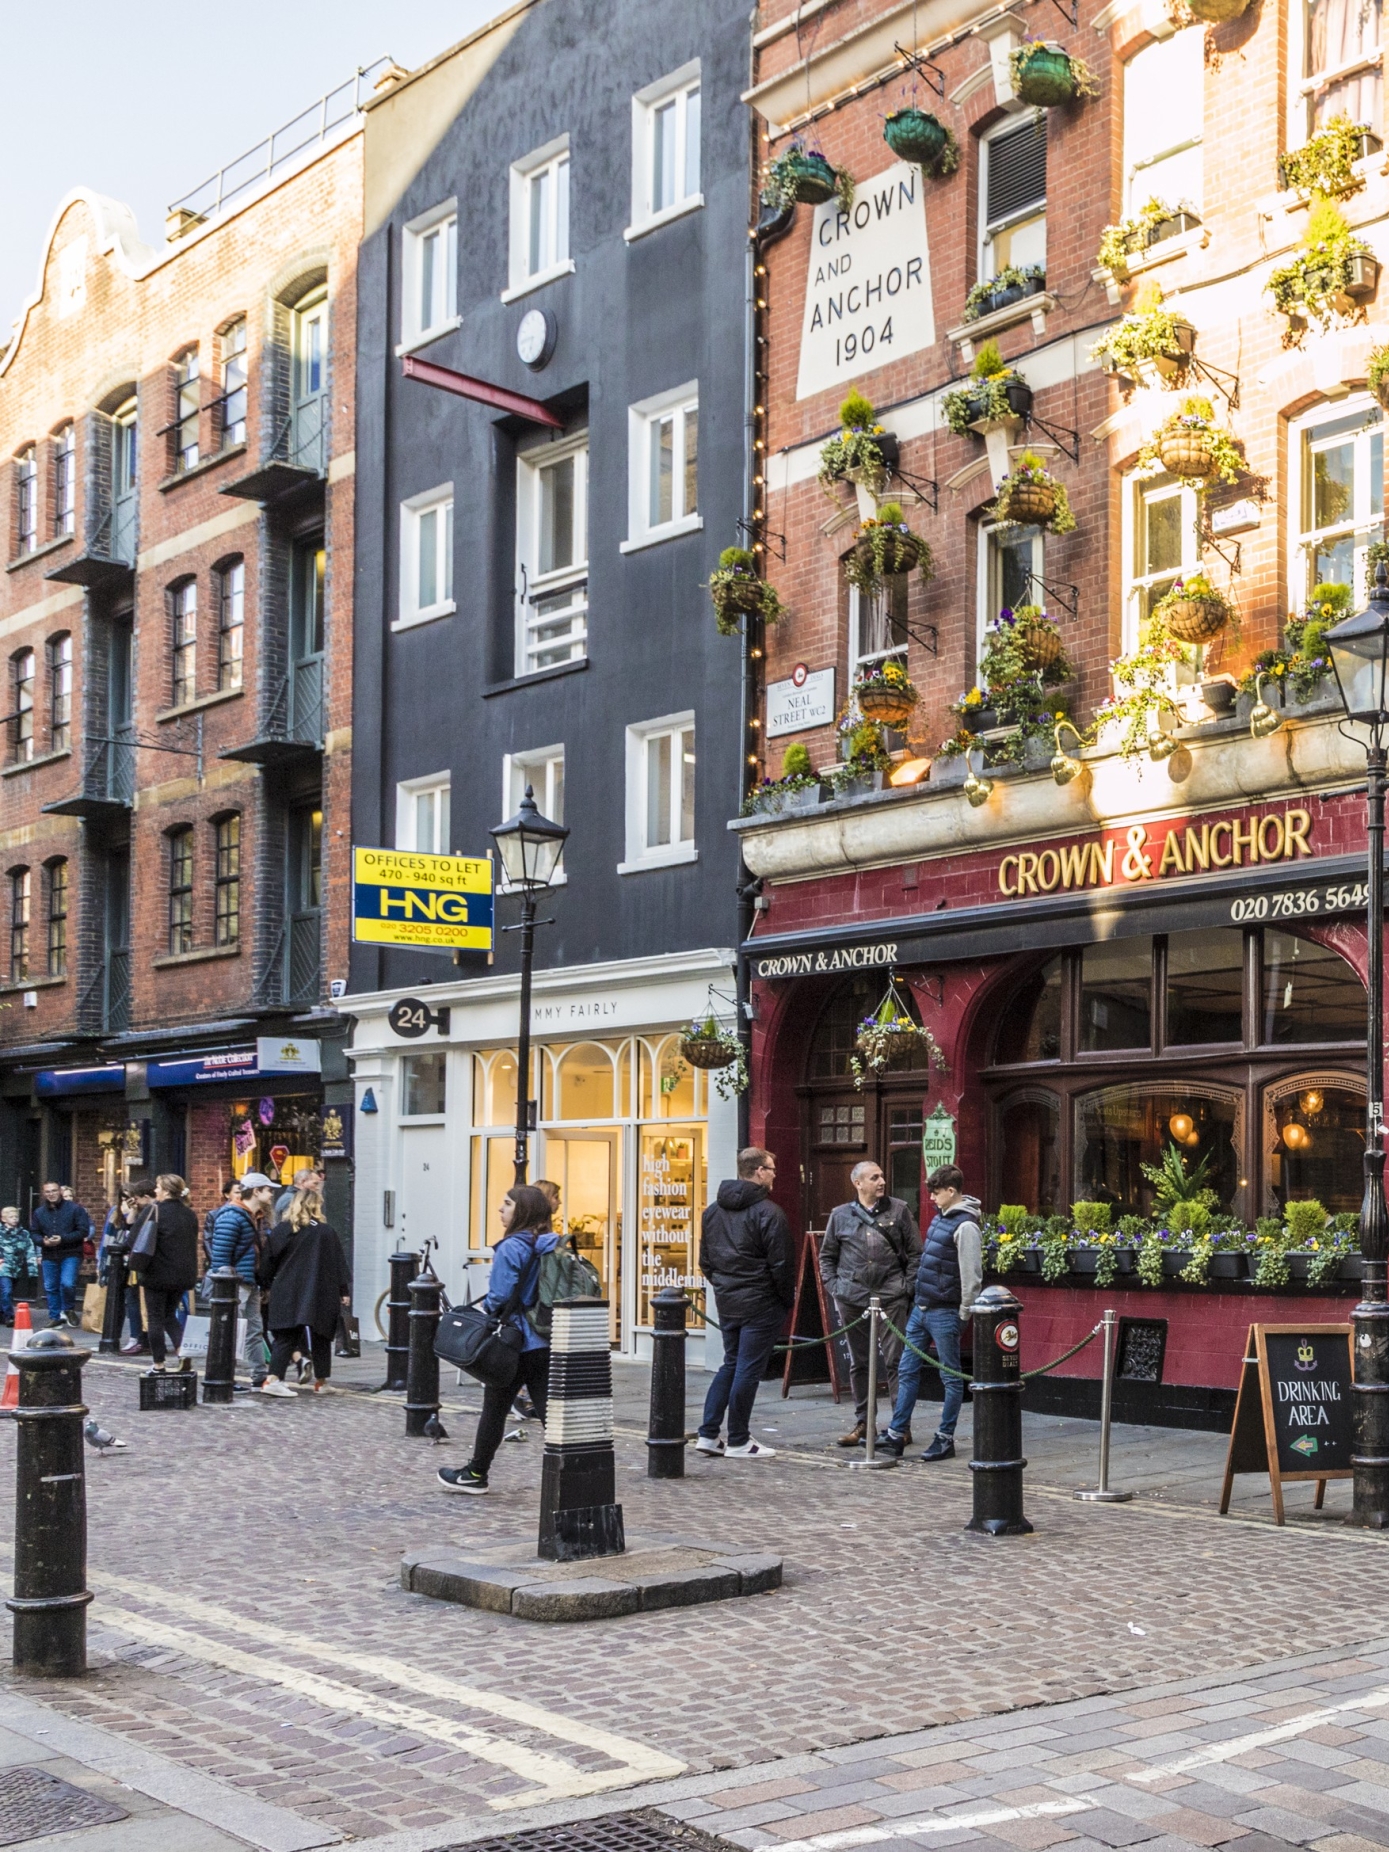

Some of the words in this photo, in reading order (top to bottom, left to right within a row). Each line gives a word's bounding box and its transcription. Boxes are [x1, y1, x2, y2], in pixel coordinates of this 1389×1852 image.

[819, 176, 915, 247] CROWN
[814, 253, 852, 287] AND
[810, 256, 923, 333] ANCHOR
[836, 316, 895, 367] 1904
[788, 694, 812, 710] NEAL
[773, 708, 807, 727] STREET
[809, 705, 826, 717] WC2
[999, 838, 1116, 897] CROWN
[1121, 825, 1153, 881] &
[1159, 808, 1313, 877] ANCHOR
[364, 853, 426, 870] OFFICES
[431, 859, 451, 872] TO
[456, 862, 482, 874] LET
[379, 869, 403, 880] 470
[413, 871, 436, 883] 940
[440, 875, 454, 886] sq
[457, 875, 467, 886] ft
[379, 888, 469, 923] HNG
[1230, 896, 1269, 922] 020
[1271, 889, 1320, 917] 7836
[380, 922, 397, 930] 020
[399, 923, 432, 935] 3205
[435, 926, 469, 938] 0200
[393, 934, 455, 945] www.hng.co.uk
[758, 953, 813, 978] CROWN
[814, 952, 828, 971] &
[828, 943, 898, 970] ANCHOR
[397, 1006, 427, 1029] 24
[570, 1001, 617, 1017] FAIRLY
[1372, 1103, 1381, 1115] 5
[422, 1162, 430, 1171] 24
[641, 1153, 671, 1178] high
[642, 1177, 687, 1196] fashion
[641, 1205, 691, 1225] eyewear
[641, 1224, 691, 1243] without
[641, 1247, 662, 1267] the
[183, 1342, 209, 1350] OFFIC
[1277, 1380, 1341, 1402] DRINKING
[1288, 1405, 1330, 1426] AREA
